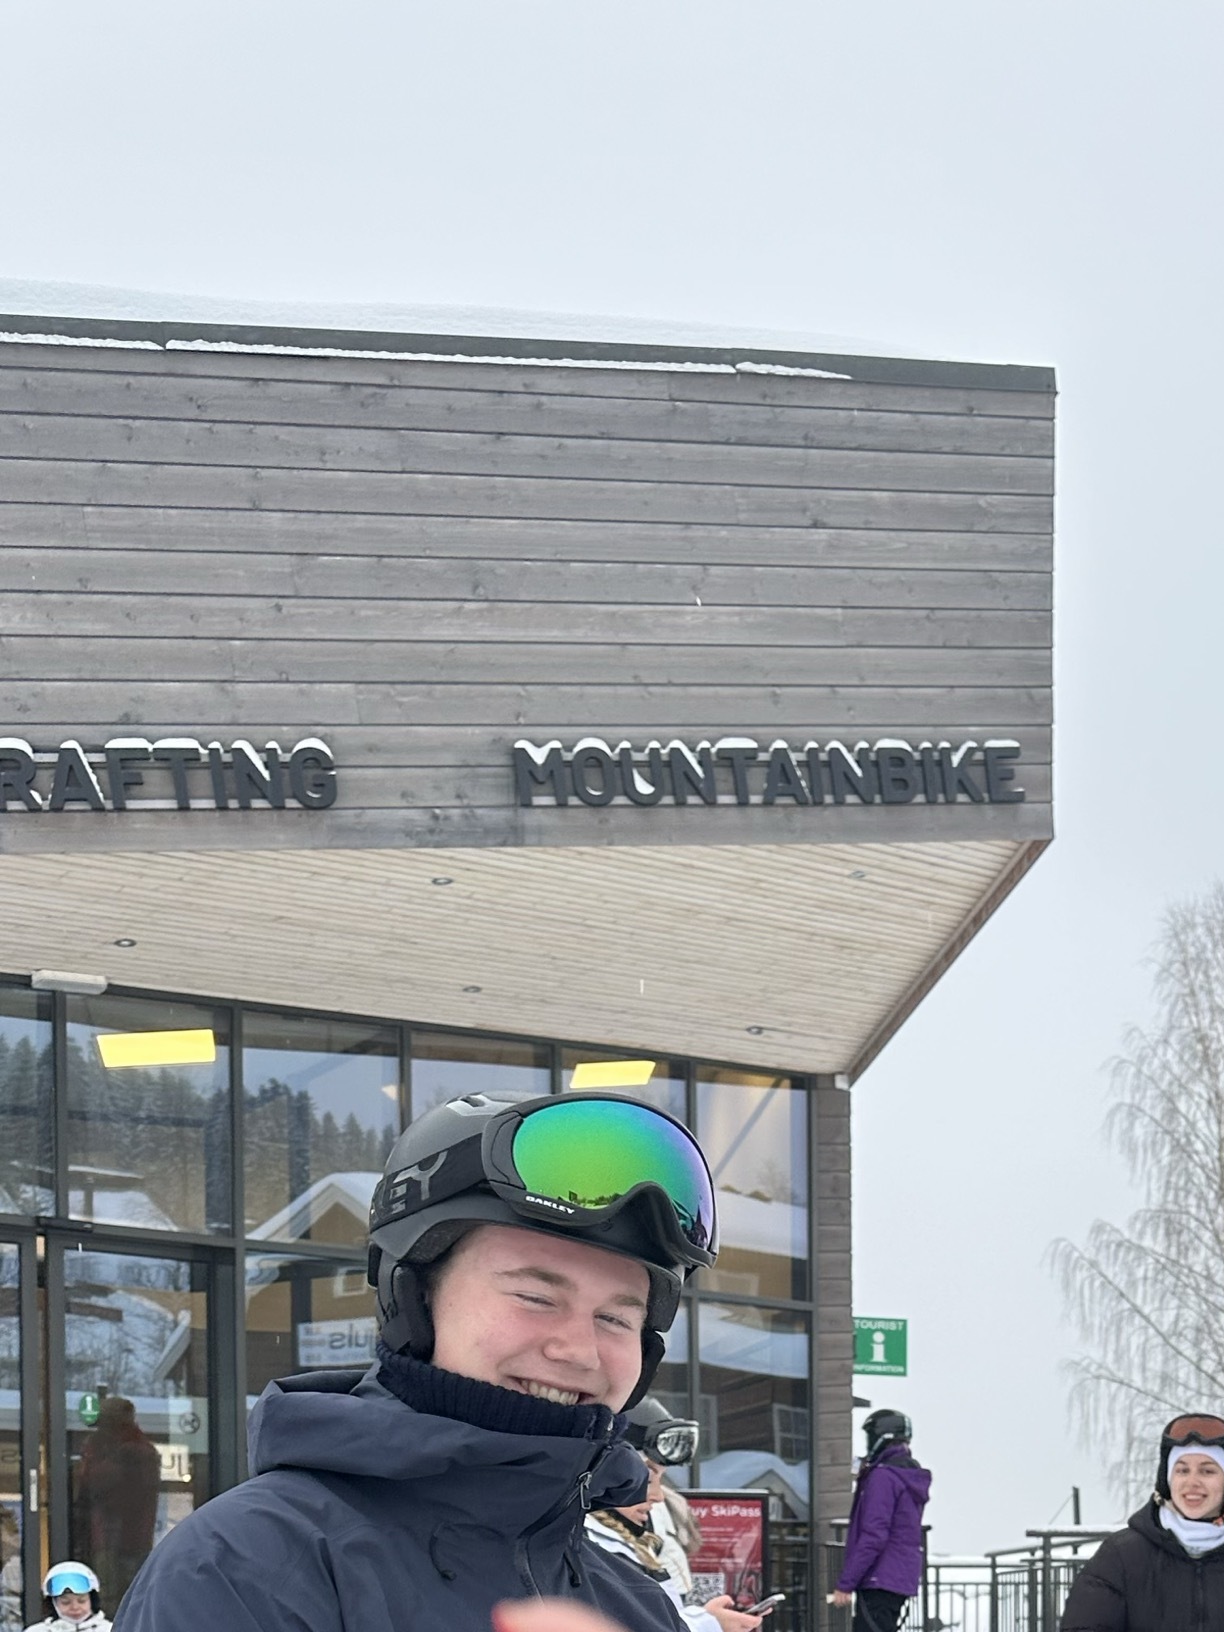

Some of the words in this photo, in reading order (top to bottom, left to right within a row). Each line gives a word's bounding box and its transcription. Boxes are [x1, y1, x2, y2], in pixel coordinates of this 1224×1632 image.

[0, 739, 337, 810] RAFTING
[513, 740, 1026, 806] MOUNTAINBIKE
[525, 1195, 575, 1214] OAKLEY
[854, 1319, 904, 1331] TOURIST
[688, 1507, 708, 1519] uy
[711, 1505, 762, 1518] SkiPass
